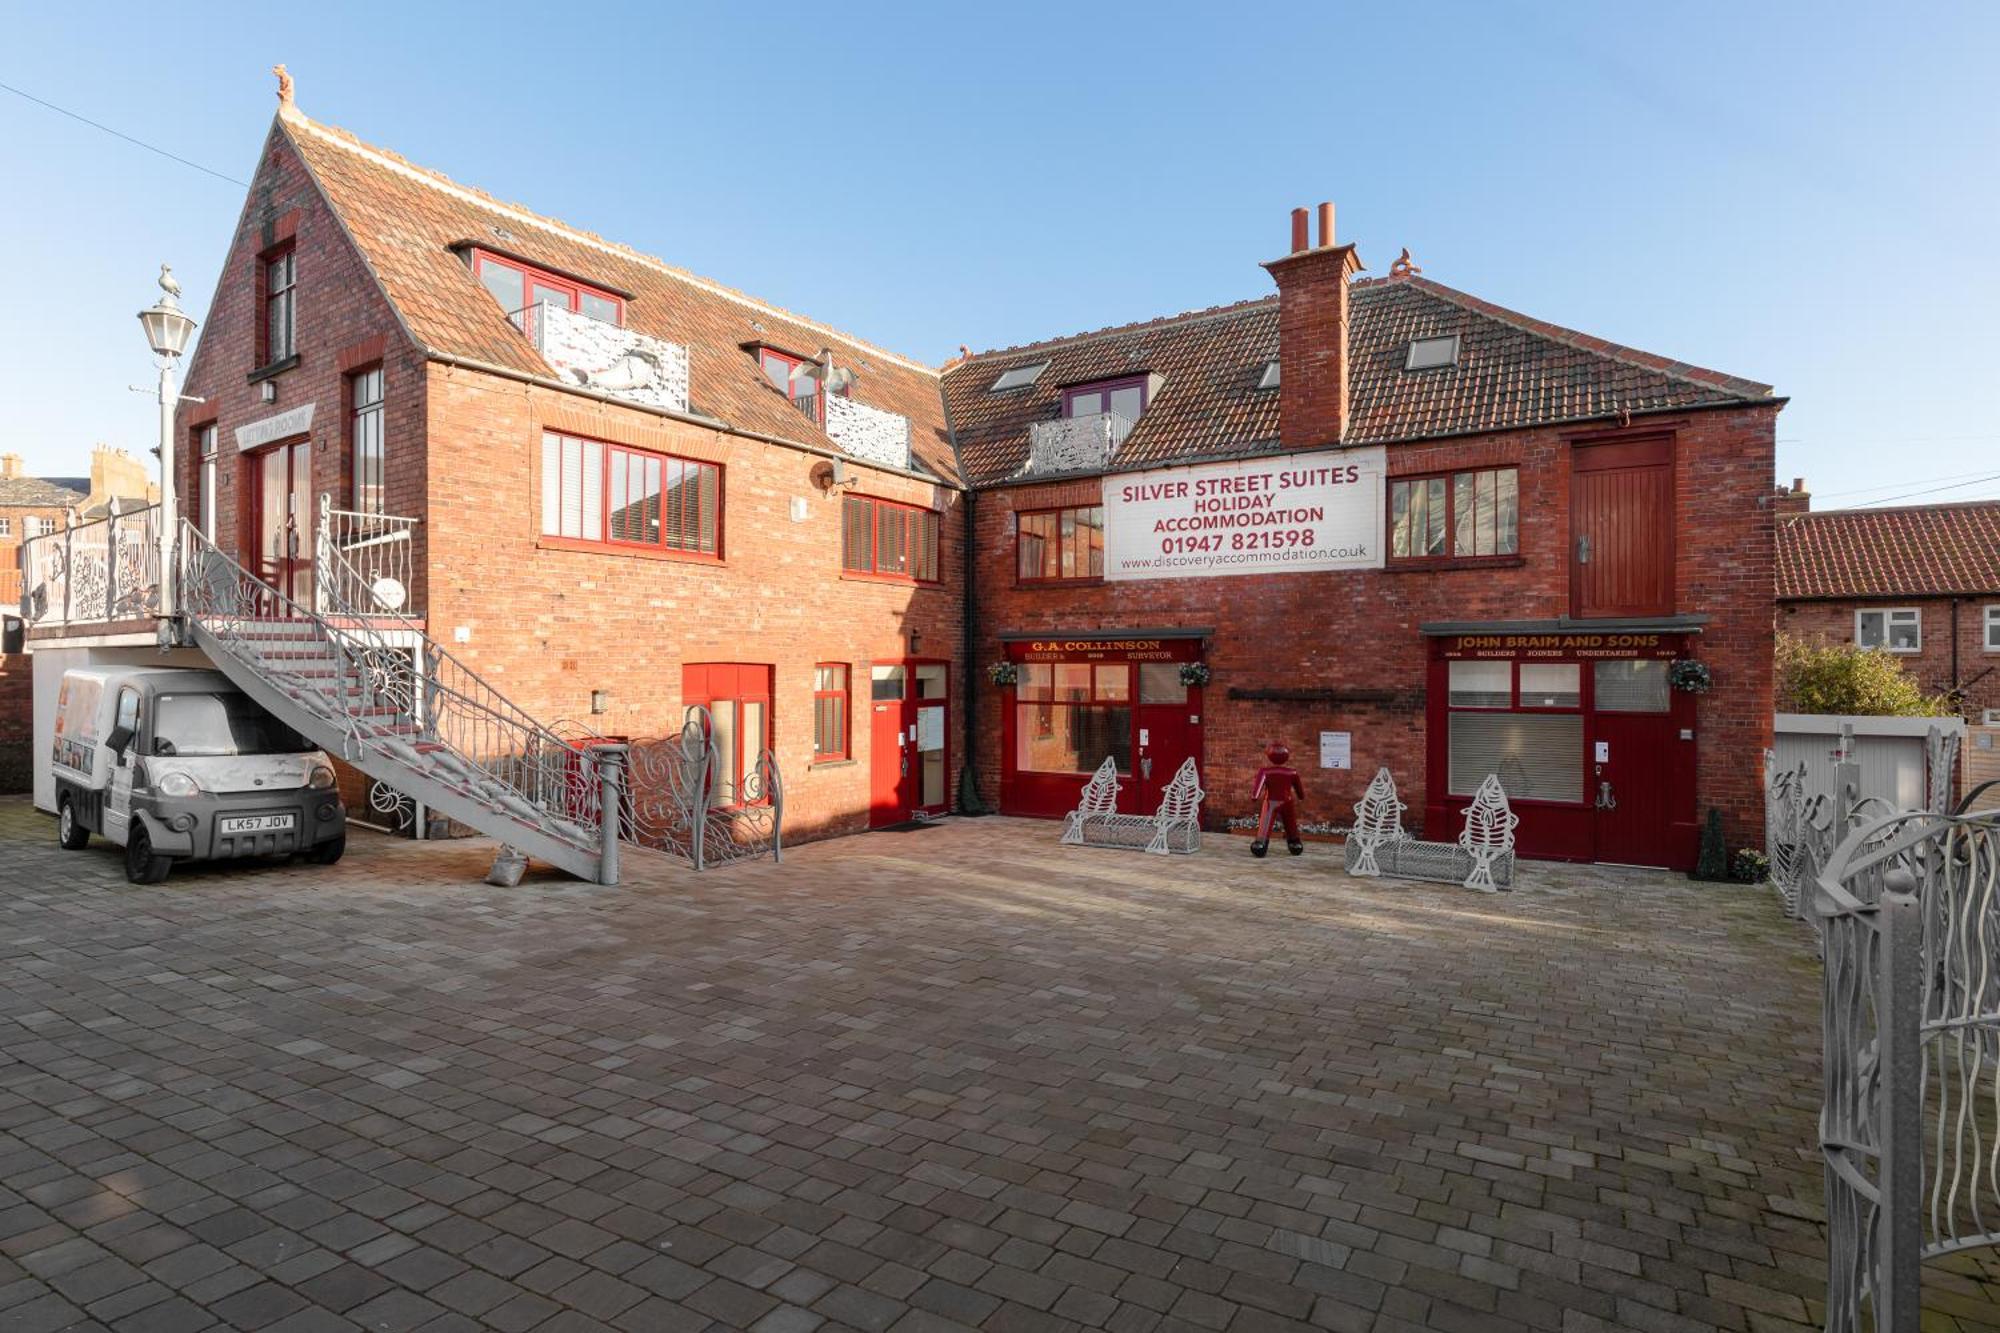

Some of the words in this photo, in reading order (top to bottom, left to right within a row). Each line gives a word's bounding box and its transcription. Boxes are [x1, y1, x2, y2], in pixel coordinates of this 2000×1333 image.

[1122, 481, 1188, 502] SILVER
[1195, 473, 1273, 496] STREET
[1279, 465, 1360, 490] SUITES
[1195, 493, 1276, 513] HOLIDAY
[1153, 507, 1324, 533] ACCOMMODATION
[1162, 535, 1223, 555] 01947
[1232, 528, 1315, 550] 821598
[1121, 544, 1367, 569] www.discoveryaccommodation.co.uk
[1457, 636, 1500, 649] JOHN
[1506, 636, 1559, 647] BRAIM
[1563, 636, 1602, 647] AND
[1608, 635, 1659, 647] SONS
[227, 818, 262, 831] LK57
[266, 816, 288, 828] JOV
